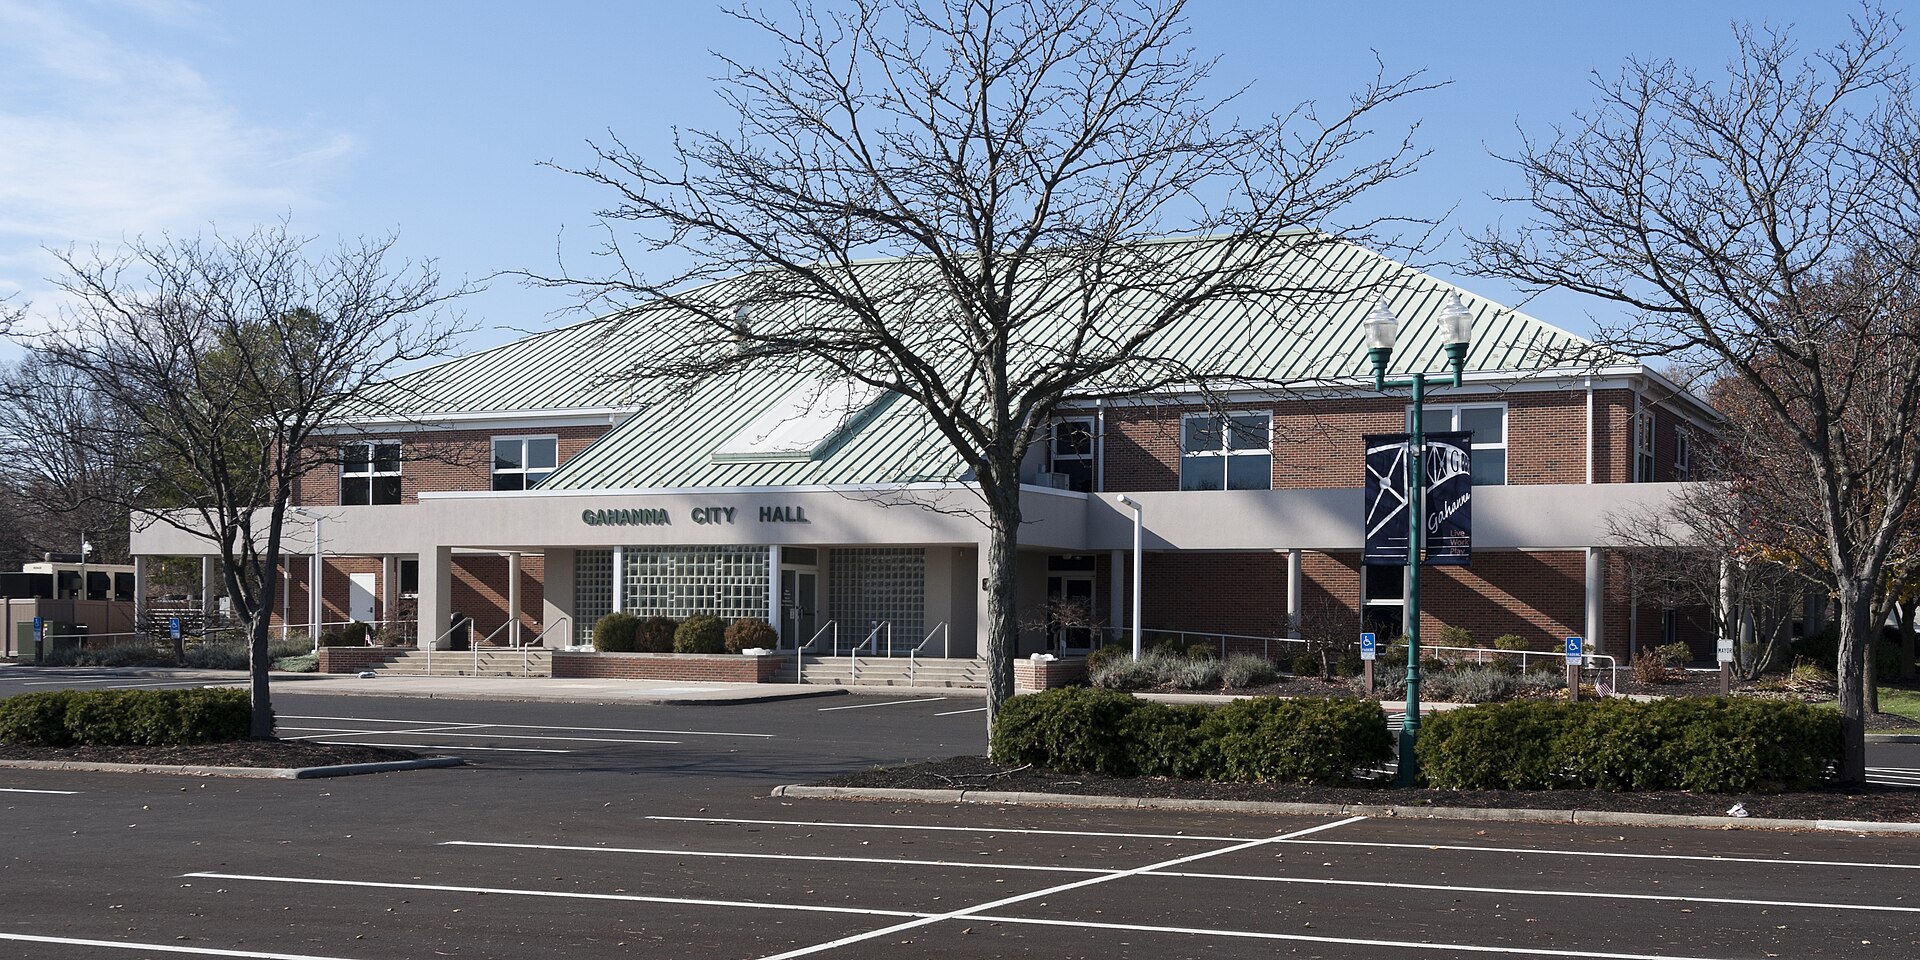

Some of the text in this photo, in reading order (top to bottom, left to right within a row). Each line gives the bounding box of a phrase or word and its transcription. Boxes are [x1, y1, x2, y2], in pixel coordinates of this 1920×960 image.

[581, 505, 809, 526] GAHANNA CITY HALL
[1450, 529, 1465, 537] Live
[1450, 538, 1469, 546] Work
[1450, 547, 1465, 555] Play
